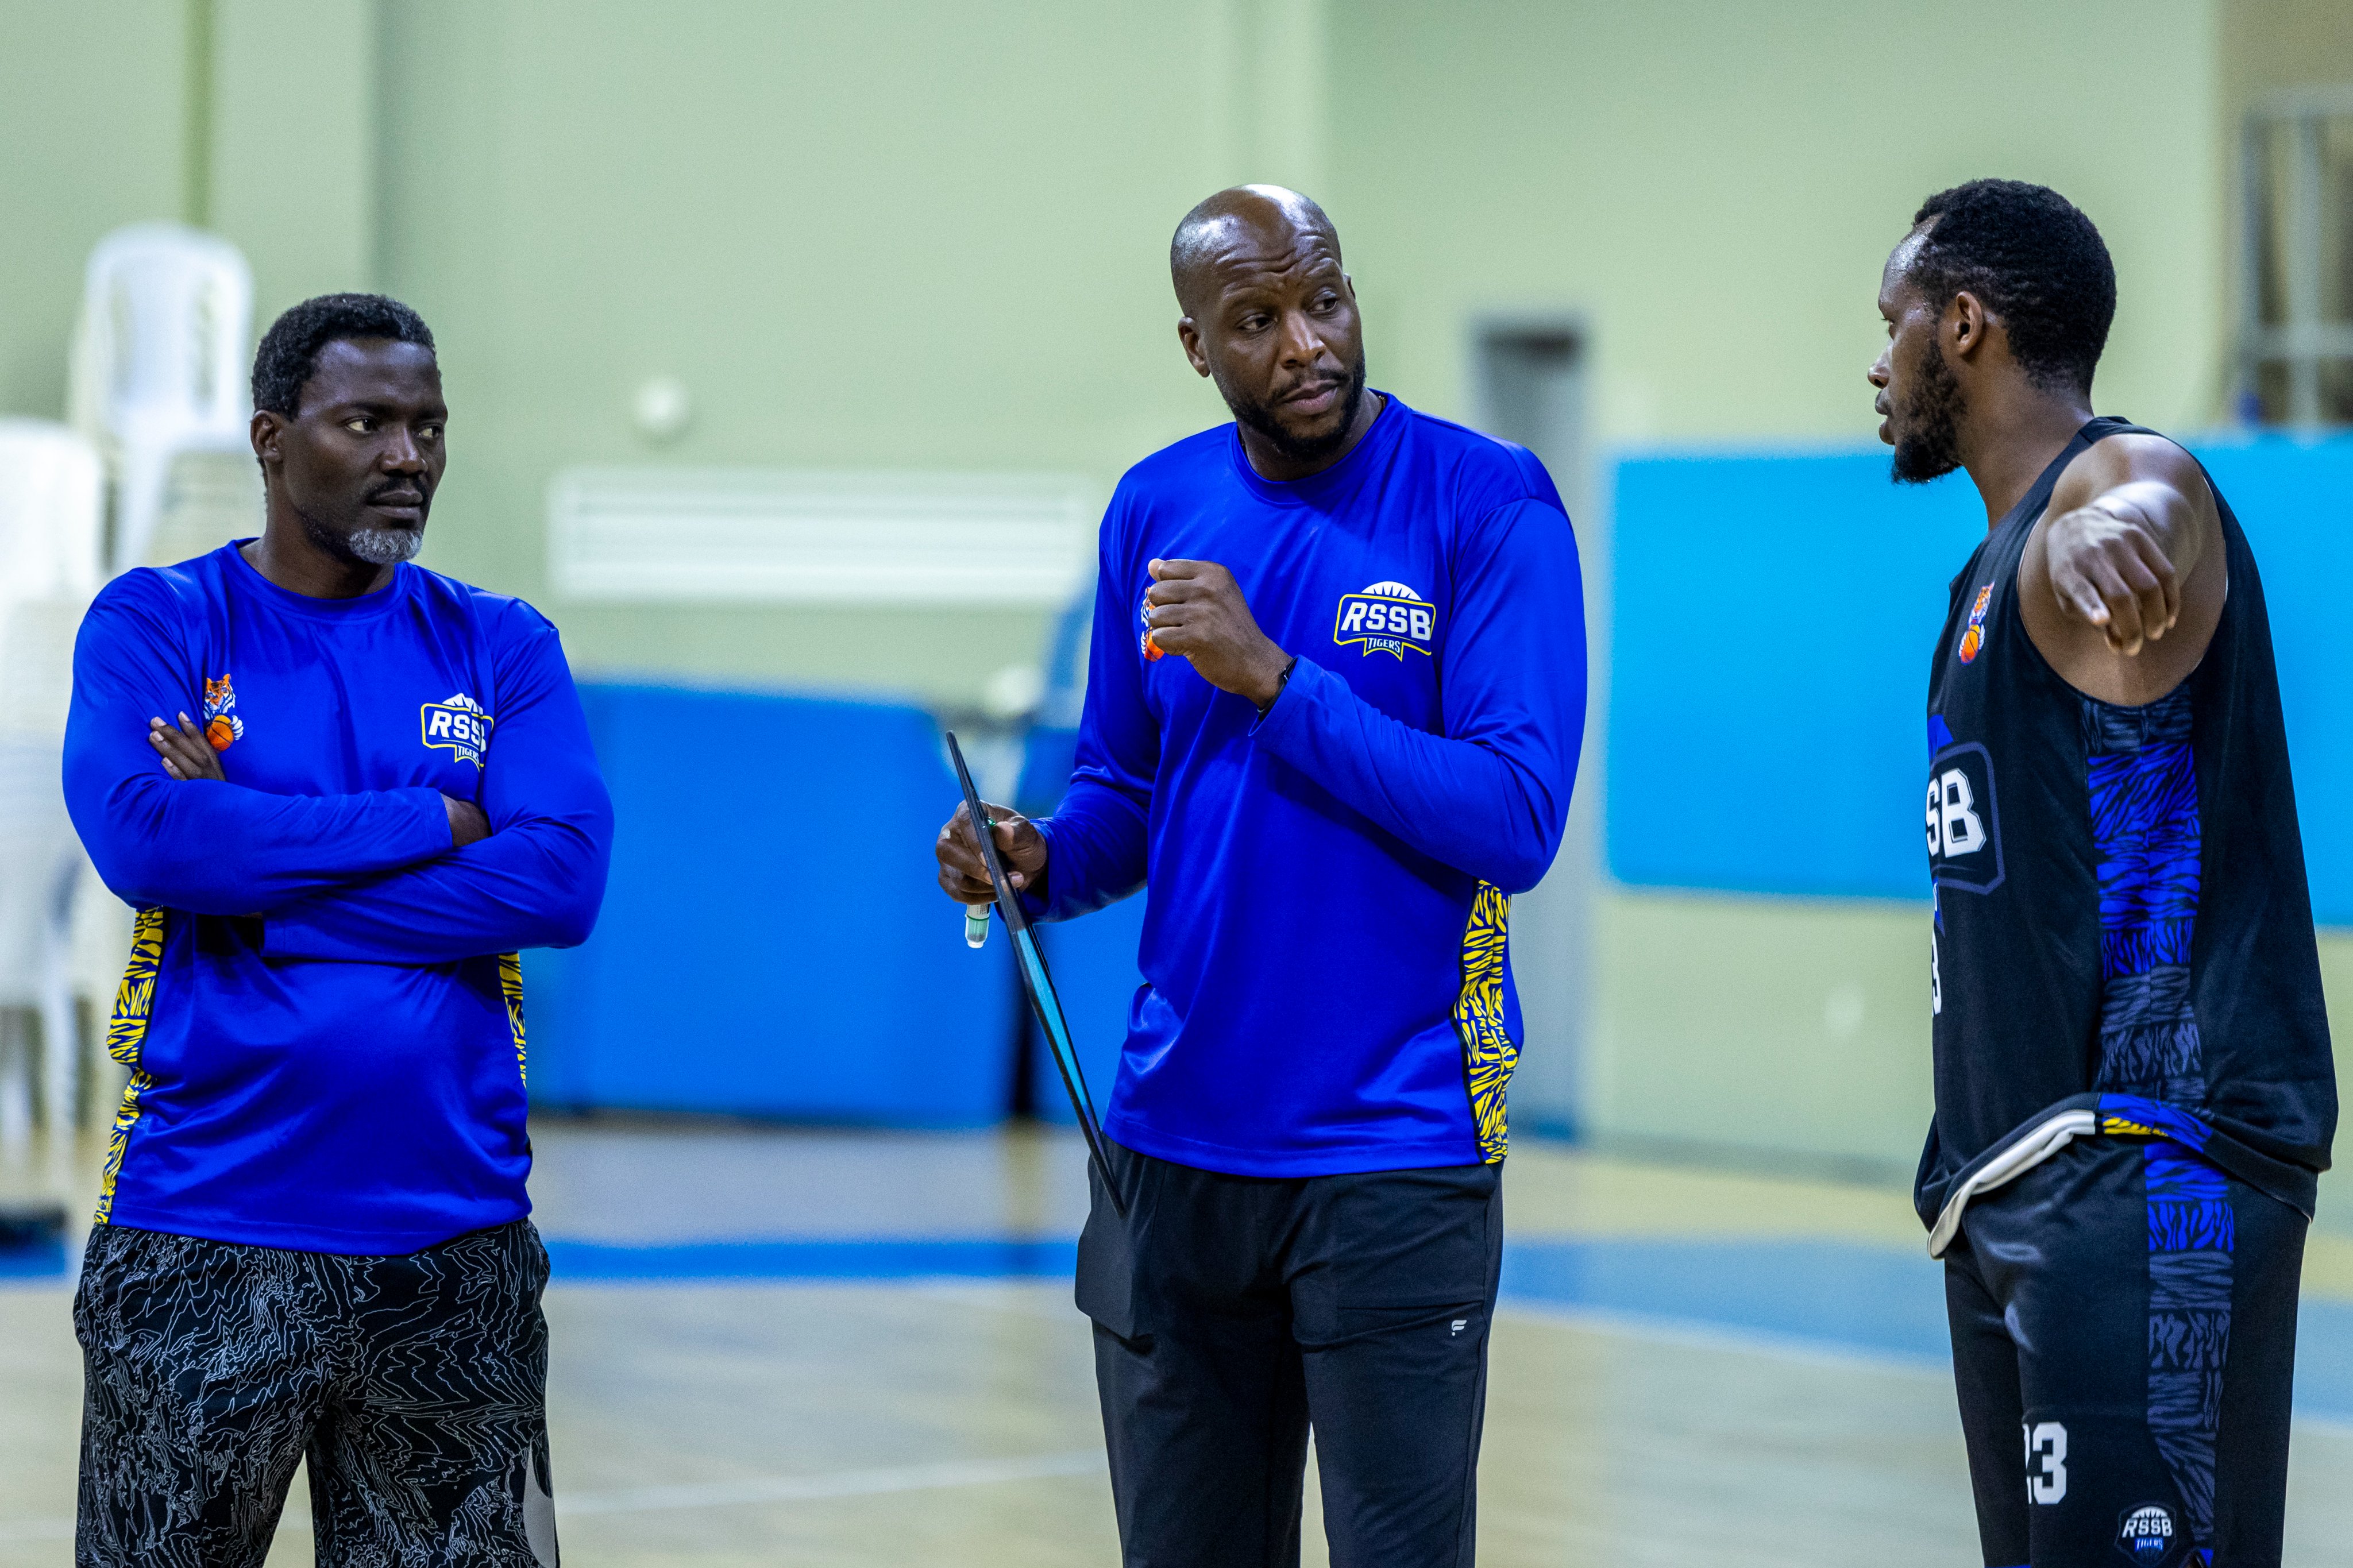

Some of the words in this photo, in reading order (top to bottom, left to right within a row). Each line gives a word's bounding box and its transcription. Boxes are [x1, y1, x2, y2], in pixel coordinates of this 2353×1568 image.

[1340, 602, 1432, 641] RSSB
[1368, 638, 1401, 654] TIGERS
[1931, 928, 1942, 1017] 3
[2122, 1517, 2173, 1538] RSSB
